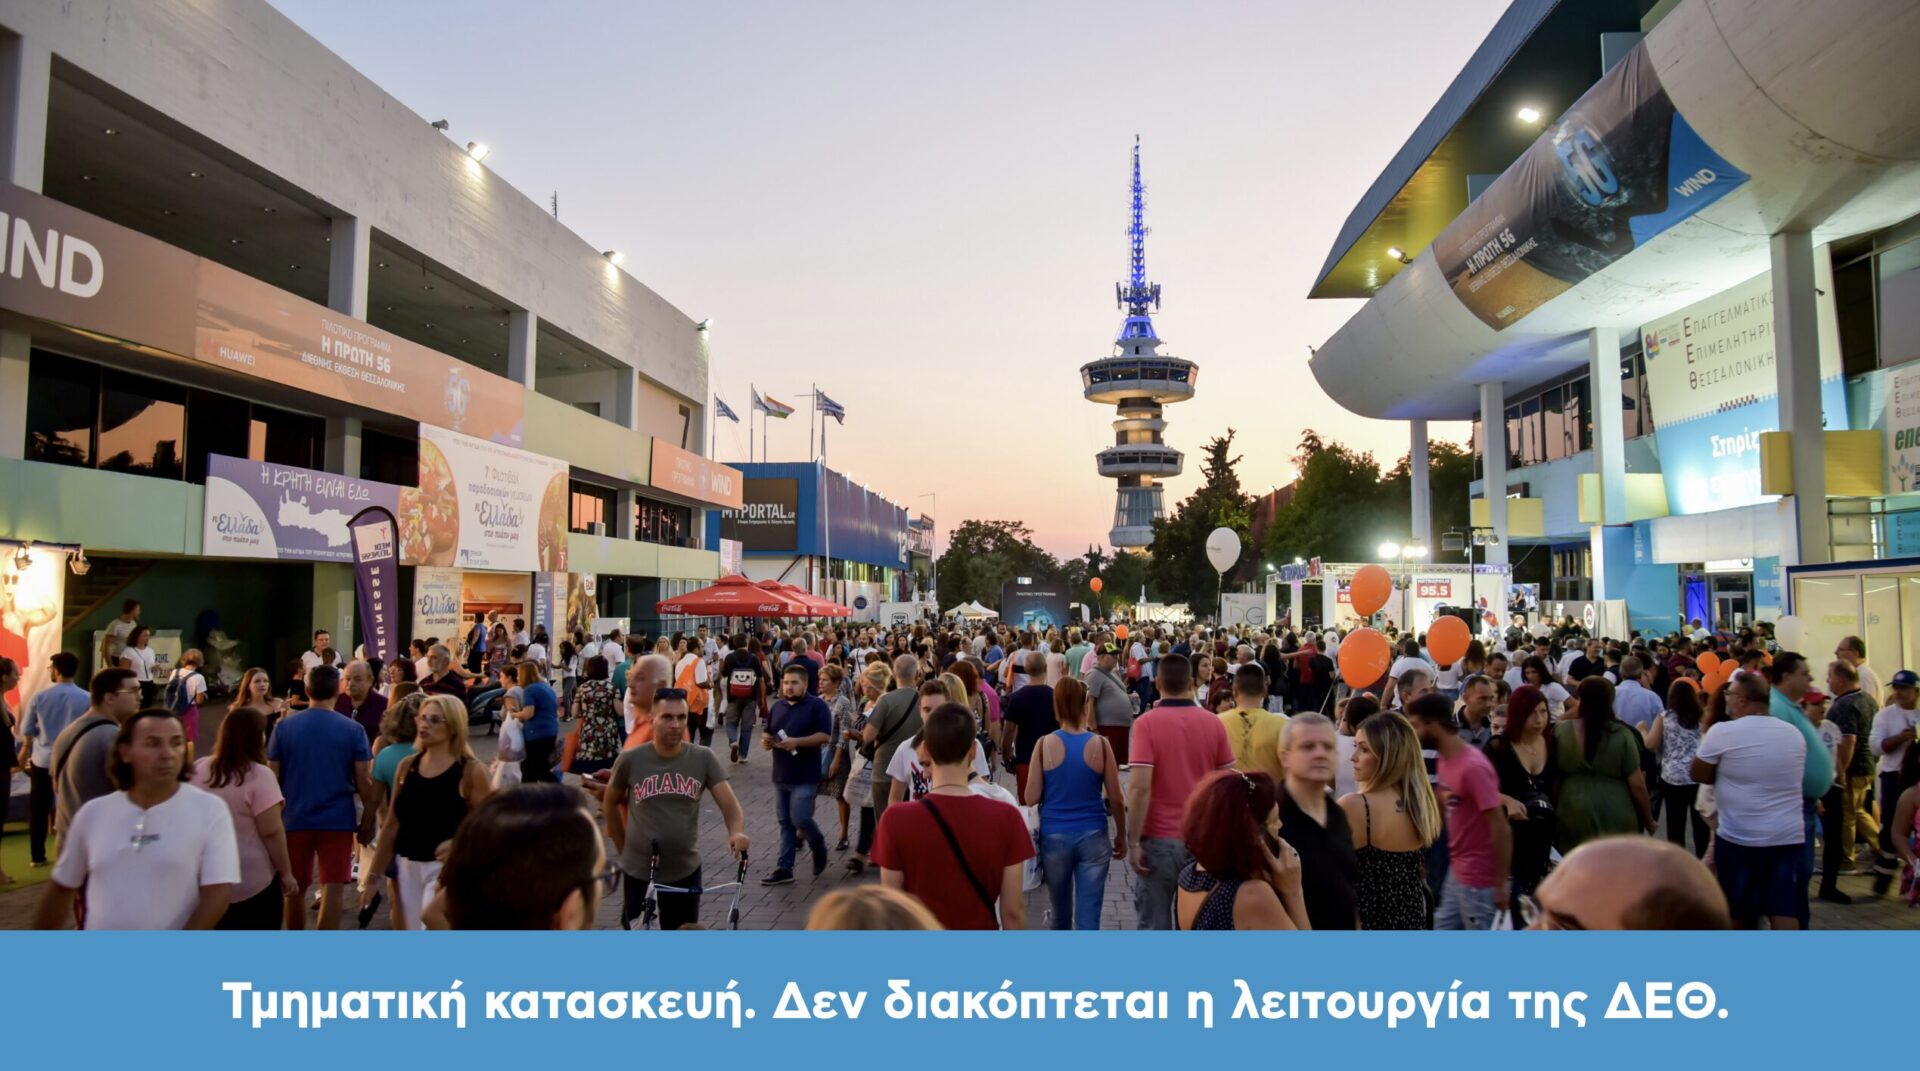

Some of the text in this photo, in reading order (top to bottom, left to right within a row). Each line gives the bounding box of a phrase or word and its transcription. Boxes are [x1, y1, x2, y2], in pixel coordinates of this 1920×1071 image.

[1674, 168, 1717, 198] WIND
[1472, 236, 1504, 269] ΠΡΩΤΗ
[1499, 227, 1516, 248] 5G
[220, 346, 256, 368] HUAWEI
[321, 335, 391, 374] Η ΠΡΩΤΗ 5G
[1686, 320, 1776, 364] ΕΠΙΜΕΛΗΤΗΡΙ
[678, 404, 691, 449] 7
[1711, 427, 1775, 458] Στηρίζ
[261, 465, 269, 485] Η
[273, 469, 312, 492] ΚΡΗΤΗ
[315, 478, 345, 499] ΕΙΝΑΙ
[711, 472, 732, 497] WIND
[1420, 585, 1449, 597] 95.5
[633, 772, 702, 805] MIAMI
